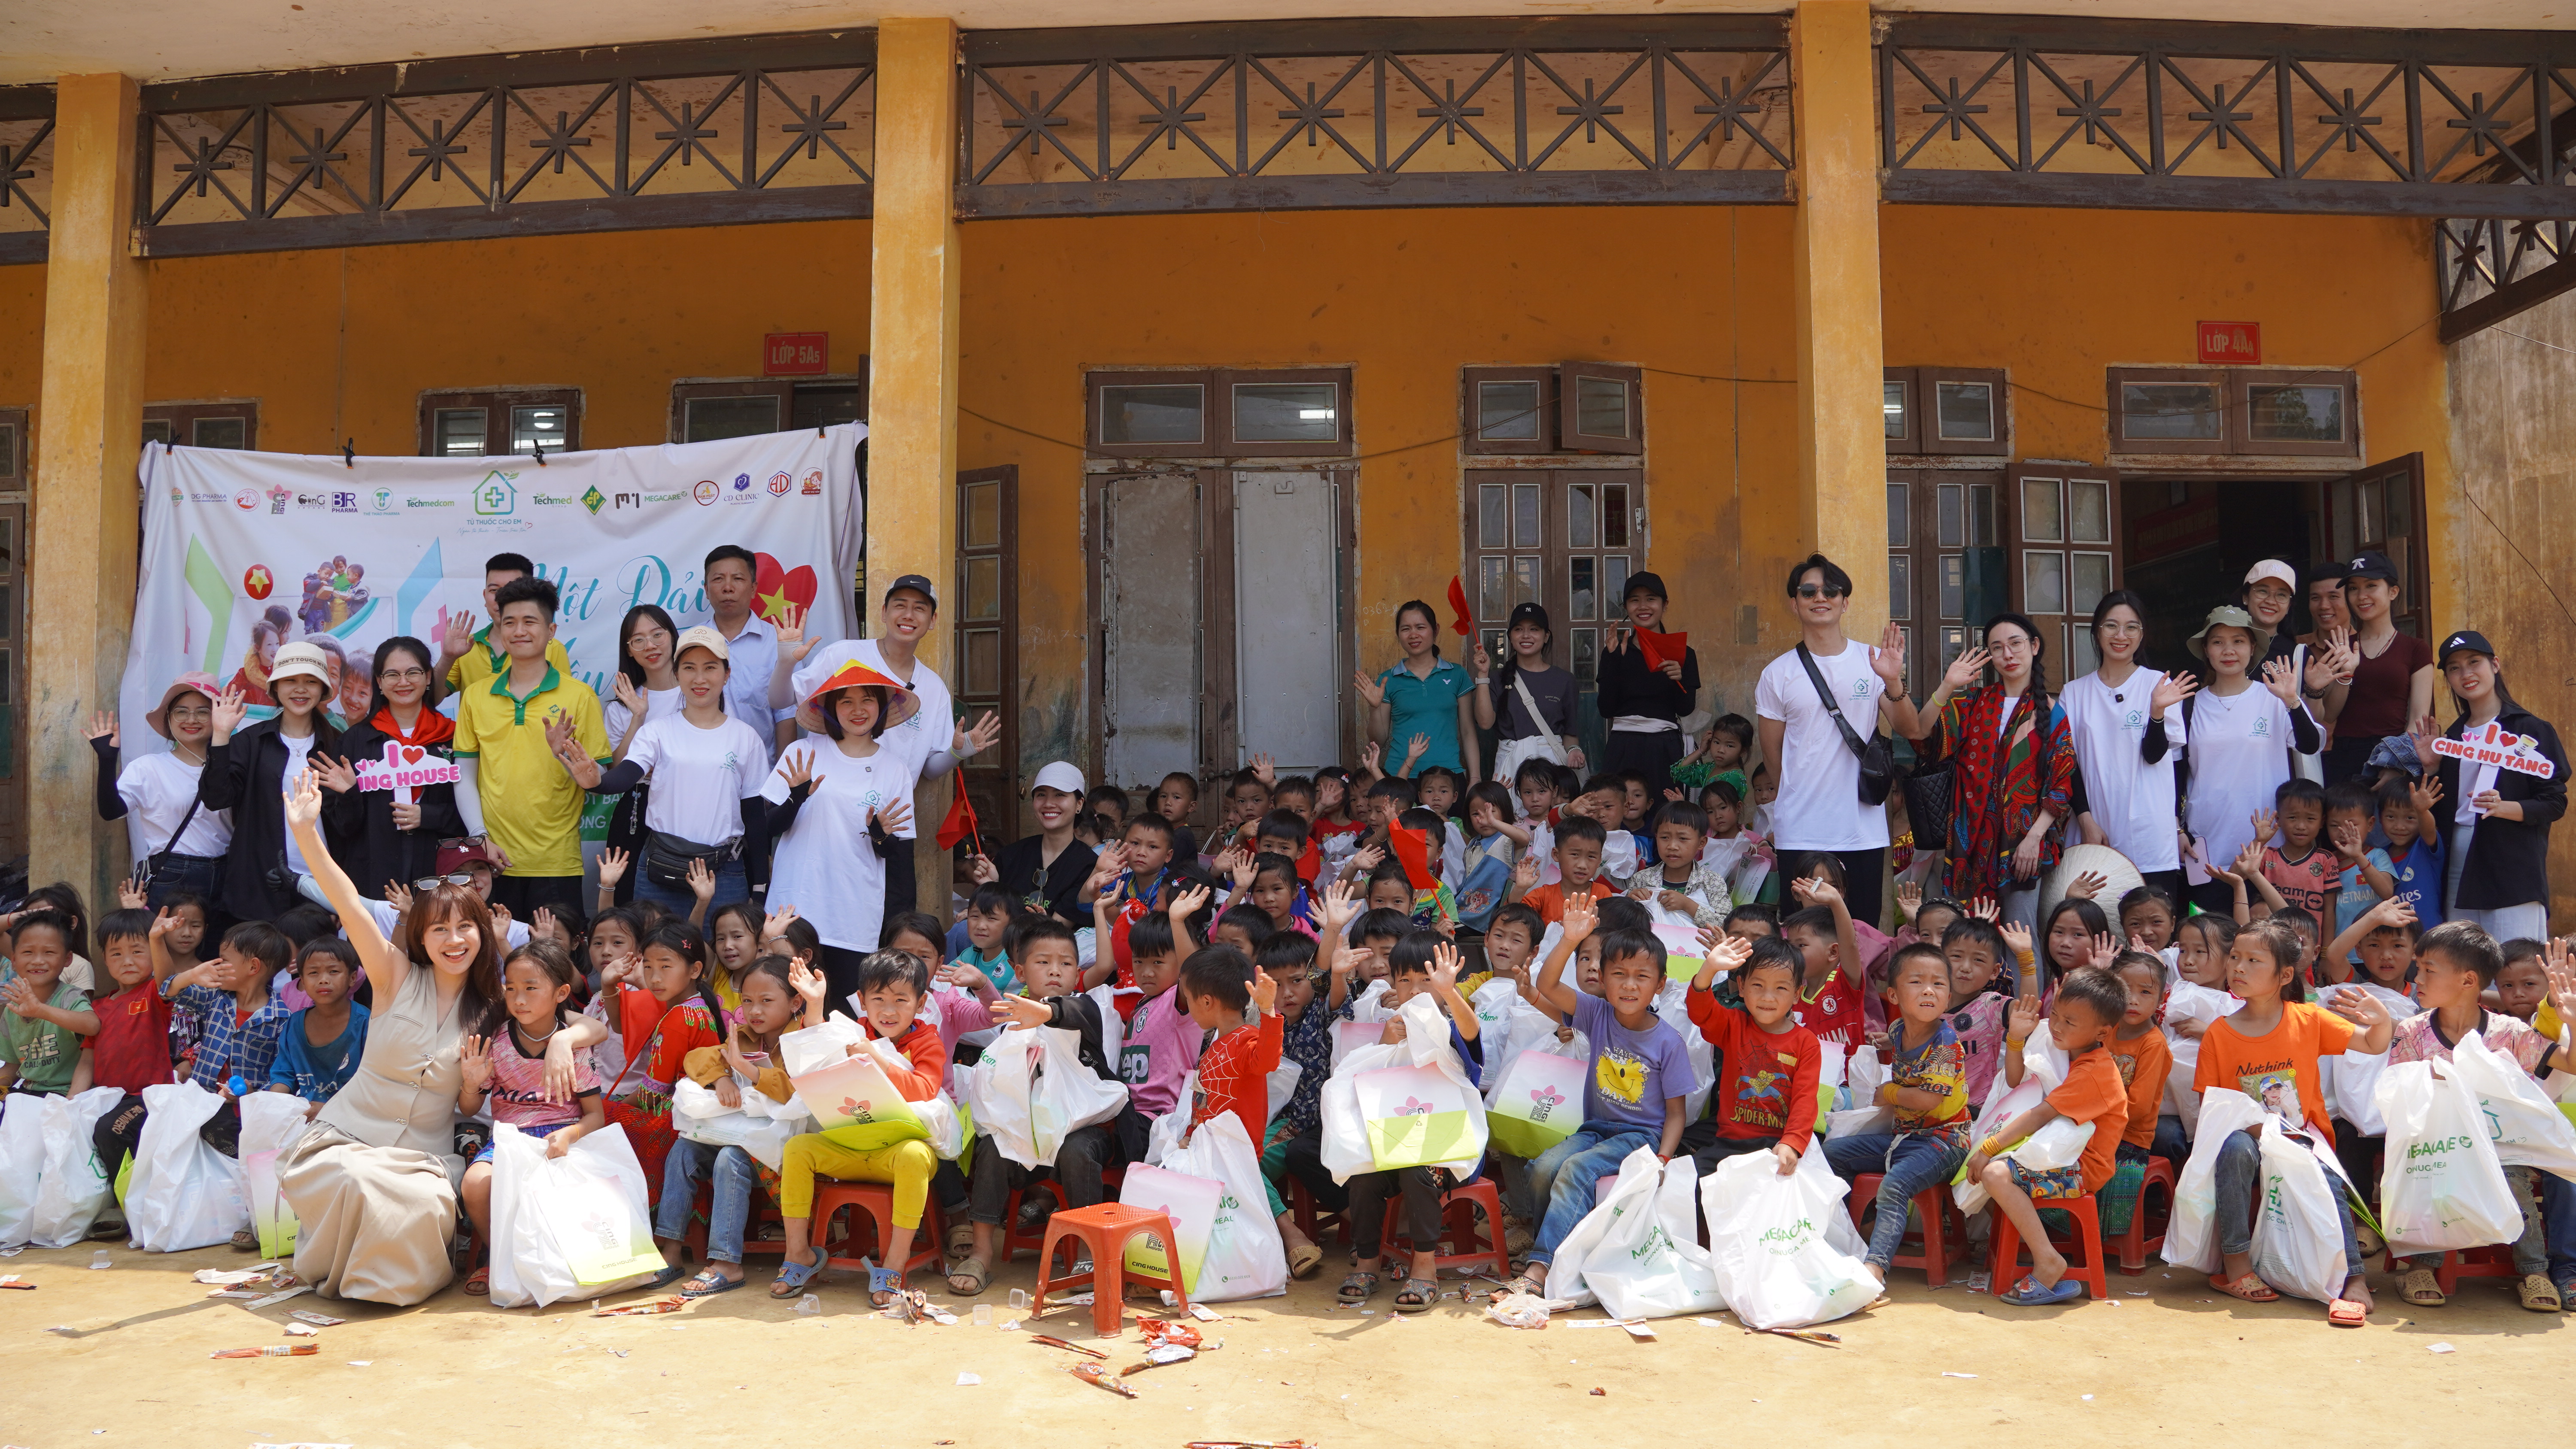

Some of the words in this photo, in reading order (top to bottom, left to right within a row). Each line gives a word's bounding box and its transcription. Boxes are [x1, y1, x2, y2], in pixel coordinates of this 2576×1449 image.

[2206, 329, 2229, 352] LỚP
[772, 341, 795, 364] LỚP
[799, 346, 820, 364] 5A5
[332, 492, 356, 507] BR
[533, 496, 572, 505] Techmed
[2485, 724, 2498, 744] I
[387, 744, 399, 768] I
[2434, 740, 2474, 761] CING
[2477, 749, 2503, 764] HU
[2505, 755, 2551, 776] TANG
[356, 774, 391, 791] ING
[396, 766, 459, 787] HOUSE
[24, 1060, 39, 1068] CALL
[41, 1056, 60, 1066] DUTY
[2236, 1058, 2294, 1076] Nuthink
[617, 1257, 638, 1266] HOUSE
[1147, 1264, 1168, 1274] HOUSE
